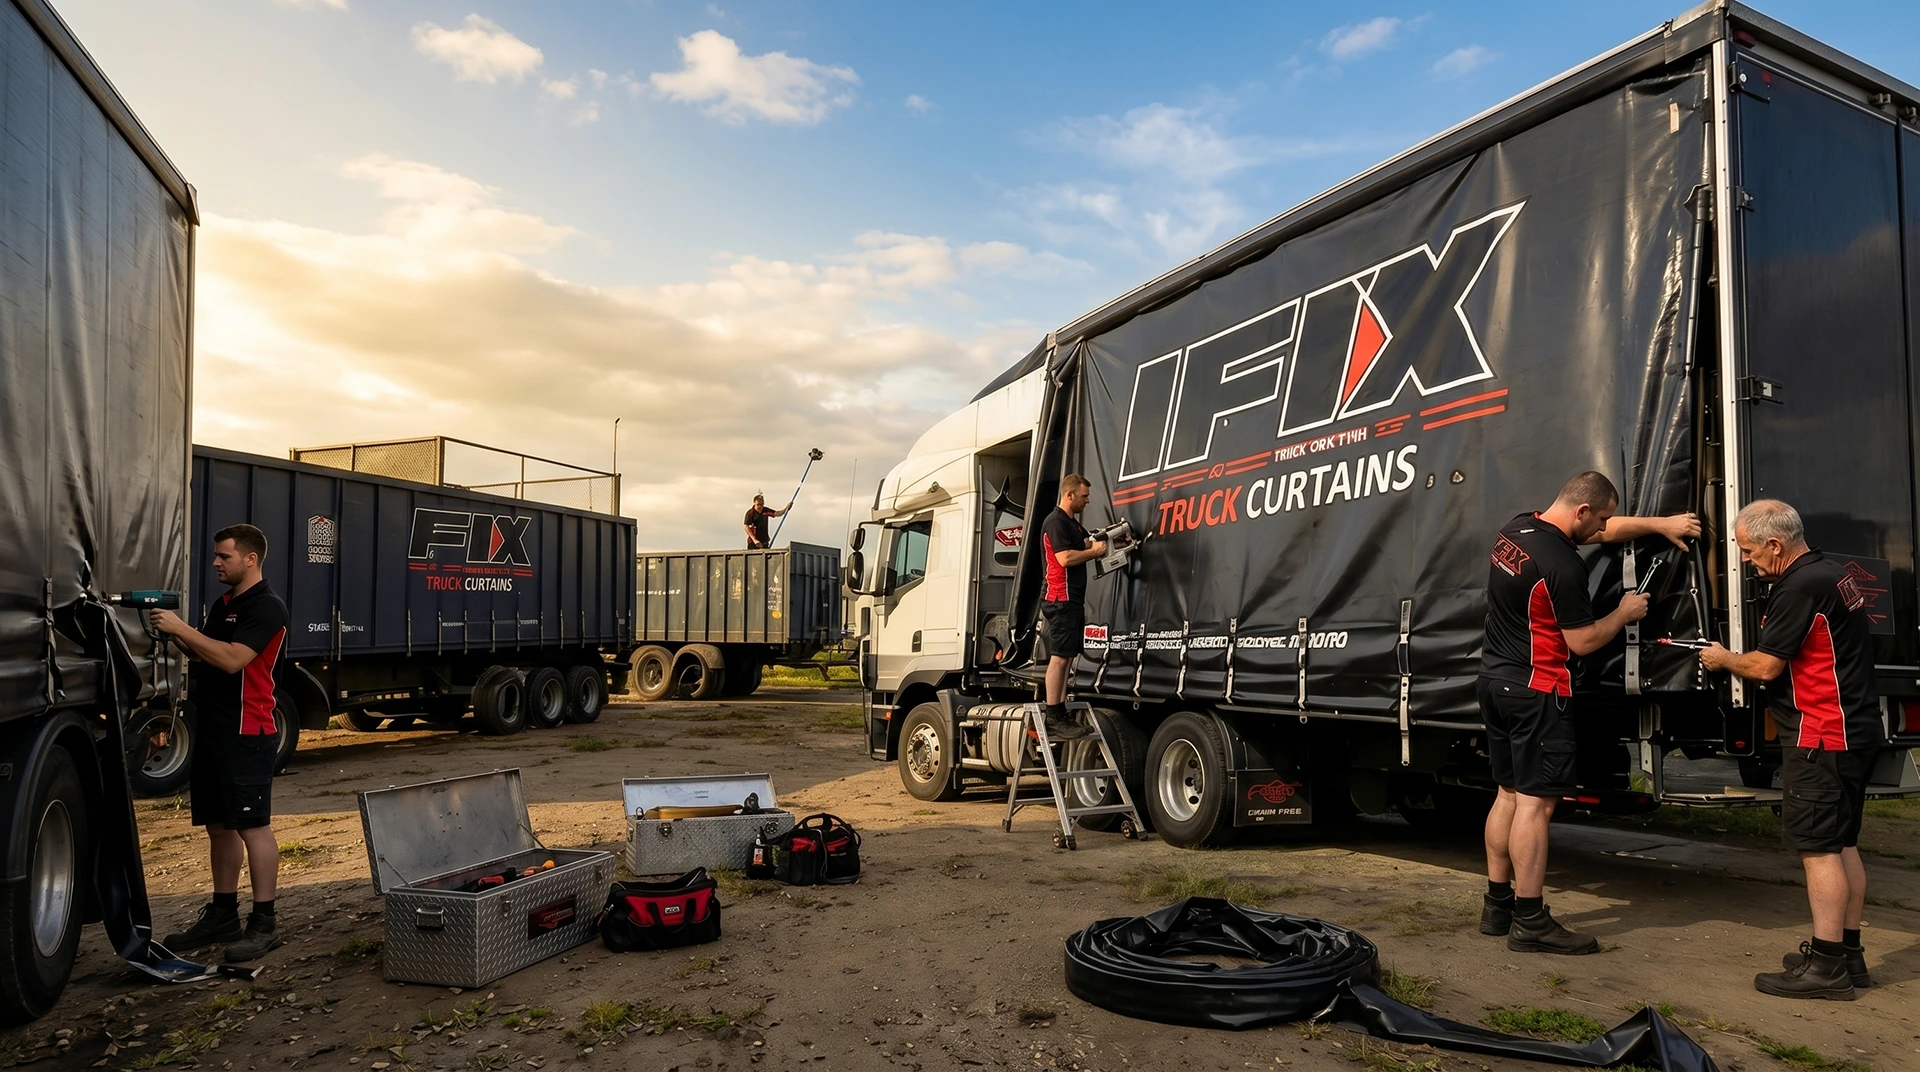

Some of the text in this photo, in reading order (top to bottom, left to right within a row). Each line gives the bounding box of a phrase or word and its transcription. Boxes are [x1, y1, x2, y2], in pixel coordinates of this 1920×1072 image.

[1118, 200, 1527, 483] IFIX
[1158, 444, 1418, 535] TRUCK CURTAINS
[408, 507, 533, 567] FIX
[426, 576, 513, 592] TRUCK CURTAINS
